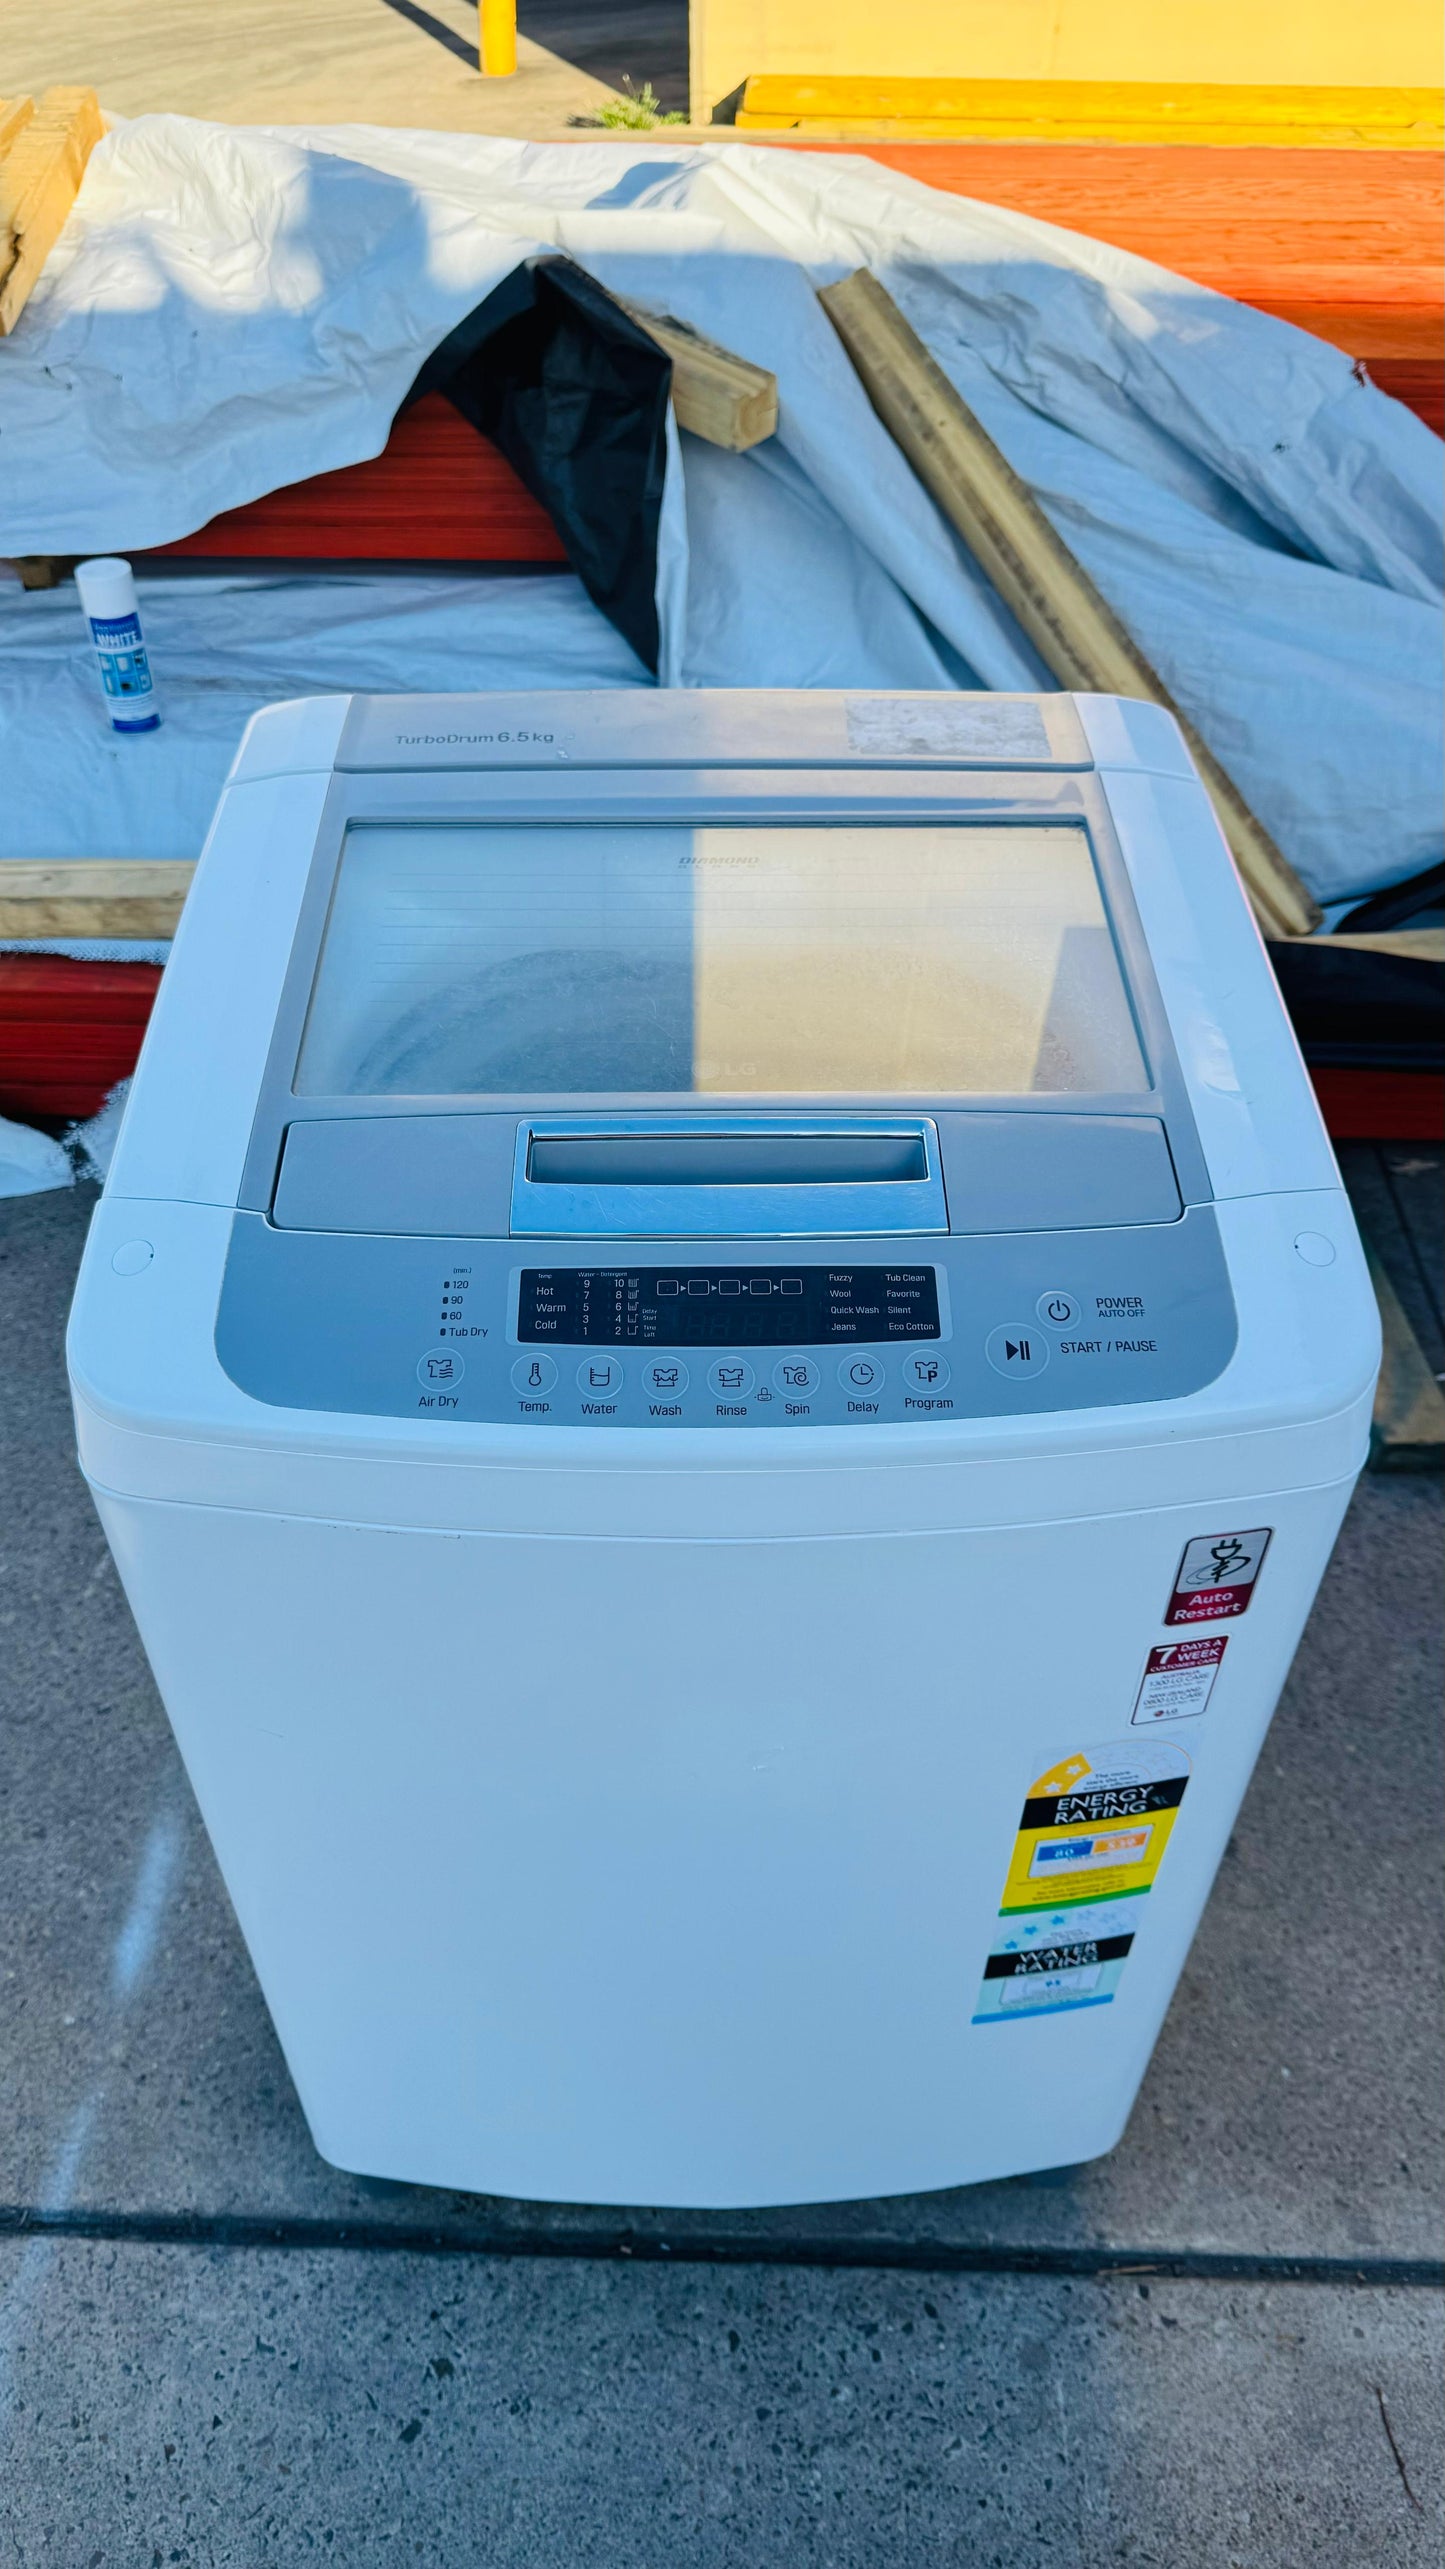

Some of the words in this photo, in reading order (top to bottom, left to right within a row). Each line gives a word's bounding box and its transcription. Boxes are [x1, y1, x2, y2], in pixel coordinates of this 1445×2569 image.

[97, 631, 138, 647] WHITE
[396, 734, 495, 745] TurboDrum
[829, 1273, 853, 1283] Fuzzy
[886, 1273, 901, 1282] Tub
[902, 1273, 926, 1282] Clean
[453, 1280, 469, 1289] 120
[583, 1280, 591, 1288] 9
[614, 1279, 625, 1288] 10
[536, 1286, 554, 1296] Hot
[583, 1291, 590, 1300] 7
[615, 1290, 622, 1299] 8
[830, 1289, 851, 1298] Wool
[886, 1289, 920, 1298] Favorite
[451, 1296, 463, 1305] 90
[1096, 1297, 1144, 1309] POWER
[536, 1303, 567, 1313] Warm
[583, 1303, 590, 1312] 5
[615, 1303, 622, 1311] 6
[831, 1305, 854, 1315] Quick
[855, 1305, 880, 1314] Wash
[887, 1305, 911, 1314] Silent
[449, 1311, 463, 1320] 60
[582, 1315, 589, 1324] 3
[615, 1314, 622, 1323] 4
[1098, 1309, 1126, 1318] AUTO
[1127, 1309, 1146, 1317] OFF
[535, 1320, 557, 1330] Cold
[615, 1326, 622, 1335] 2
[831, 1322, 856, 1331] Jeans
[889, 1322, 904, 1331] Eco
[906, 1322, 934, 1331] Cotton
[449, 1327, 469, 1337] Tub
[470, 1327, 489, 1338] Dry
[1060, 1341, 1102, 1354] START
[1115, 1340, 1158, 1352] PAUSE
[418, 1396, 436, 1407] Air
[438, 1395, 459, 1408] Dry
[905, 1398, 954, 1412] Program
[518, 1402, 552, 1413] Temp.
[581, 1403, 618, 1415] Water
[649, 1405, 682, 1416] Wash
[716, 1405, 747, 1416] Rinse
[785, 1403, 810, 1415] Spin
[847, 1402, 880, 1414] Delay
[1189, 1592, 1234, 1606] Auto
[1174, 1602, 1242, 1620] Restart
[1156, 1646, 1178, 1665] 7
[1180, 1641, 1211, 1653] DAYS
[1212, 1639, 1223, 1647] A
[1177, 1648, 1220, 1662] WEEK
[1057, 1785, 1155, 1811] ENERGY
[1054, 1800, 1149, 1825] RATING
[1019, 1942, 1098, 1963] WATER
[1014, 1954, 1099, 1974] RATING
